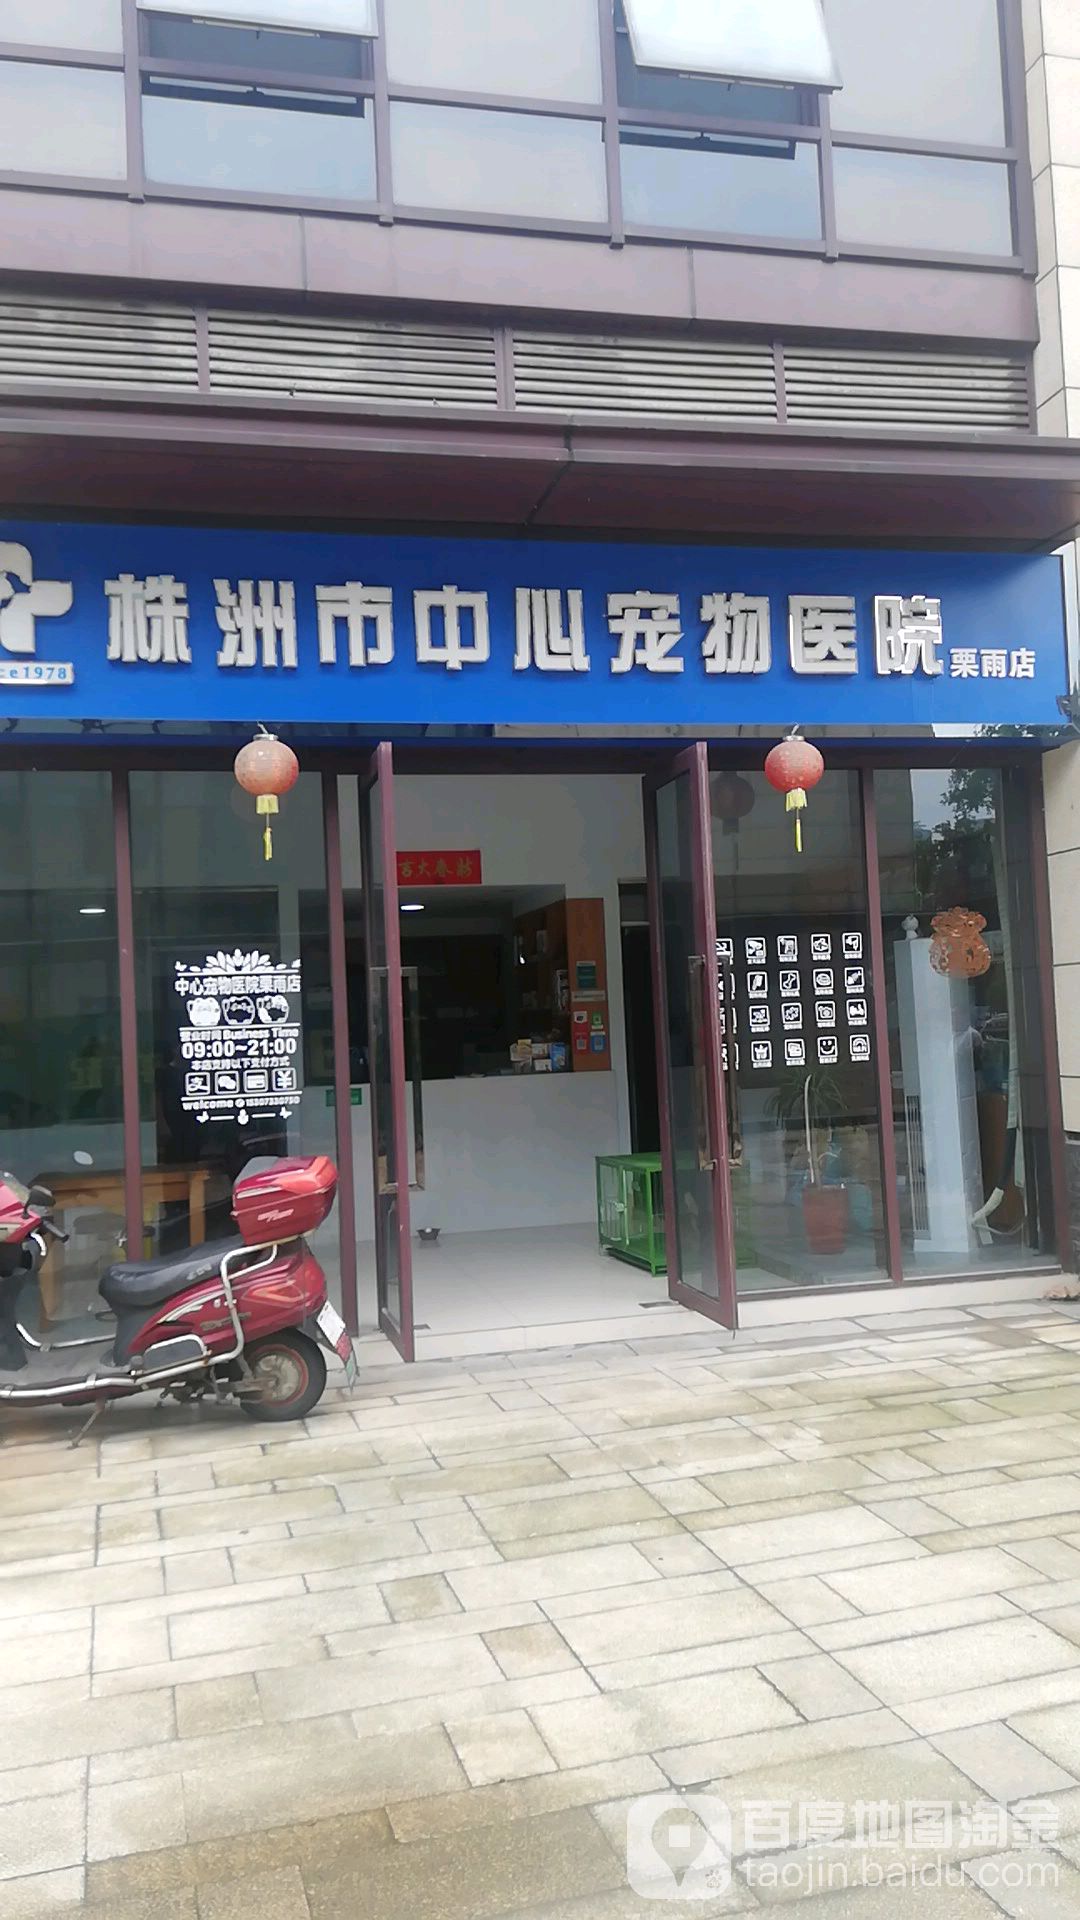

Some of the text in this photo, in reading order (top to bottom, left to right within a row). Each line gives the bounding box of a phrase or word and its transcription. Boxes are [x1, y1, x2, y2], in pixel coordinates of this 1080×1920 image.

[104, 572, 944, 678] 株洲市中心宠物医院
[949, 647, 1036, 680] 栗雨店
[174, 975, 301, 996] 中心宠物医院栗雨店
[271, 1027, 299, 1037] Time
[182, 1099, 234, 1111] welcome
